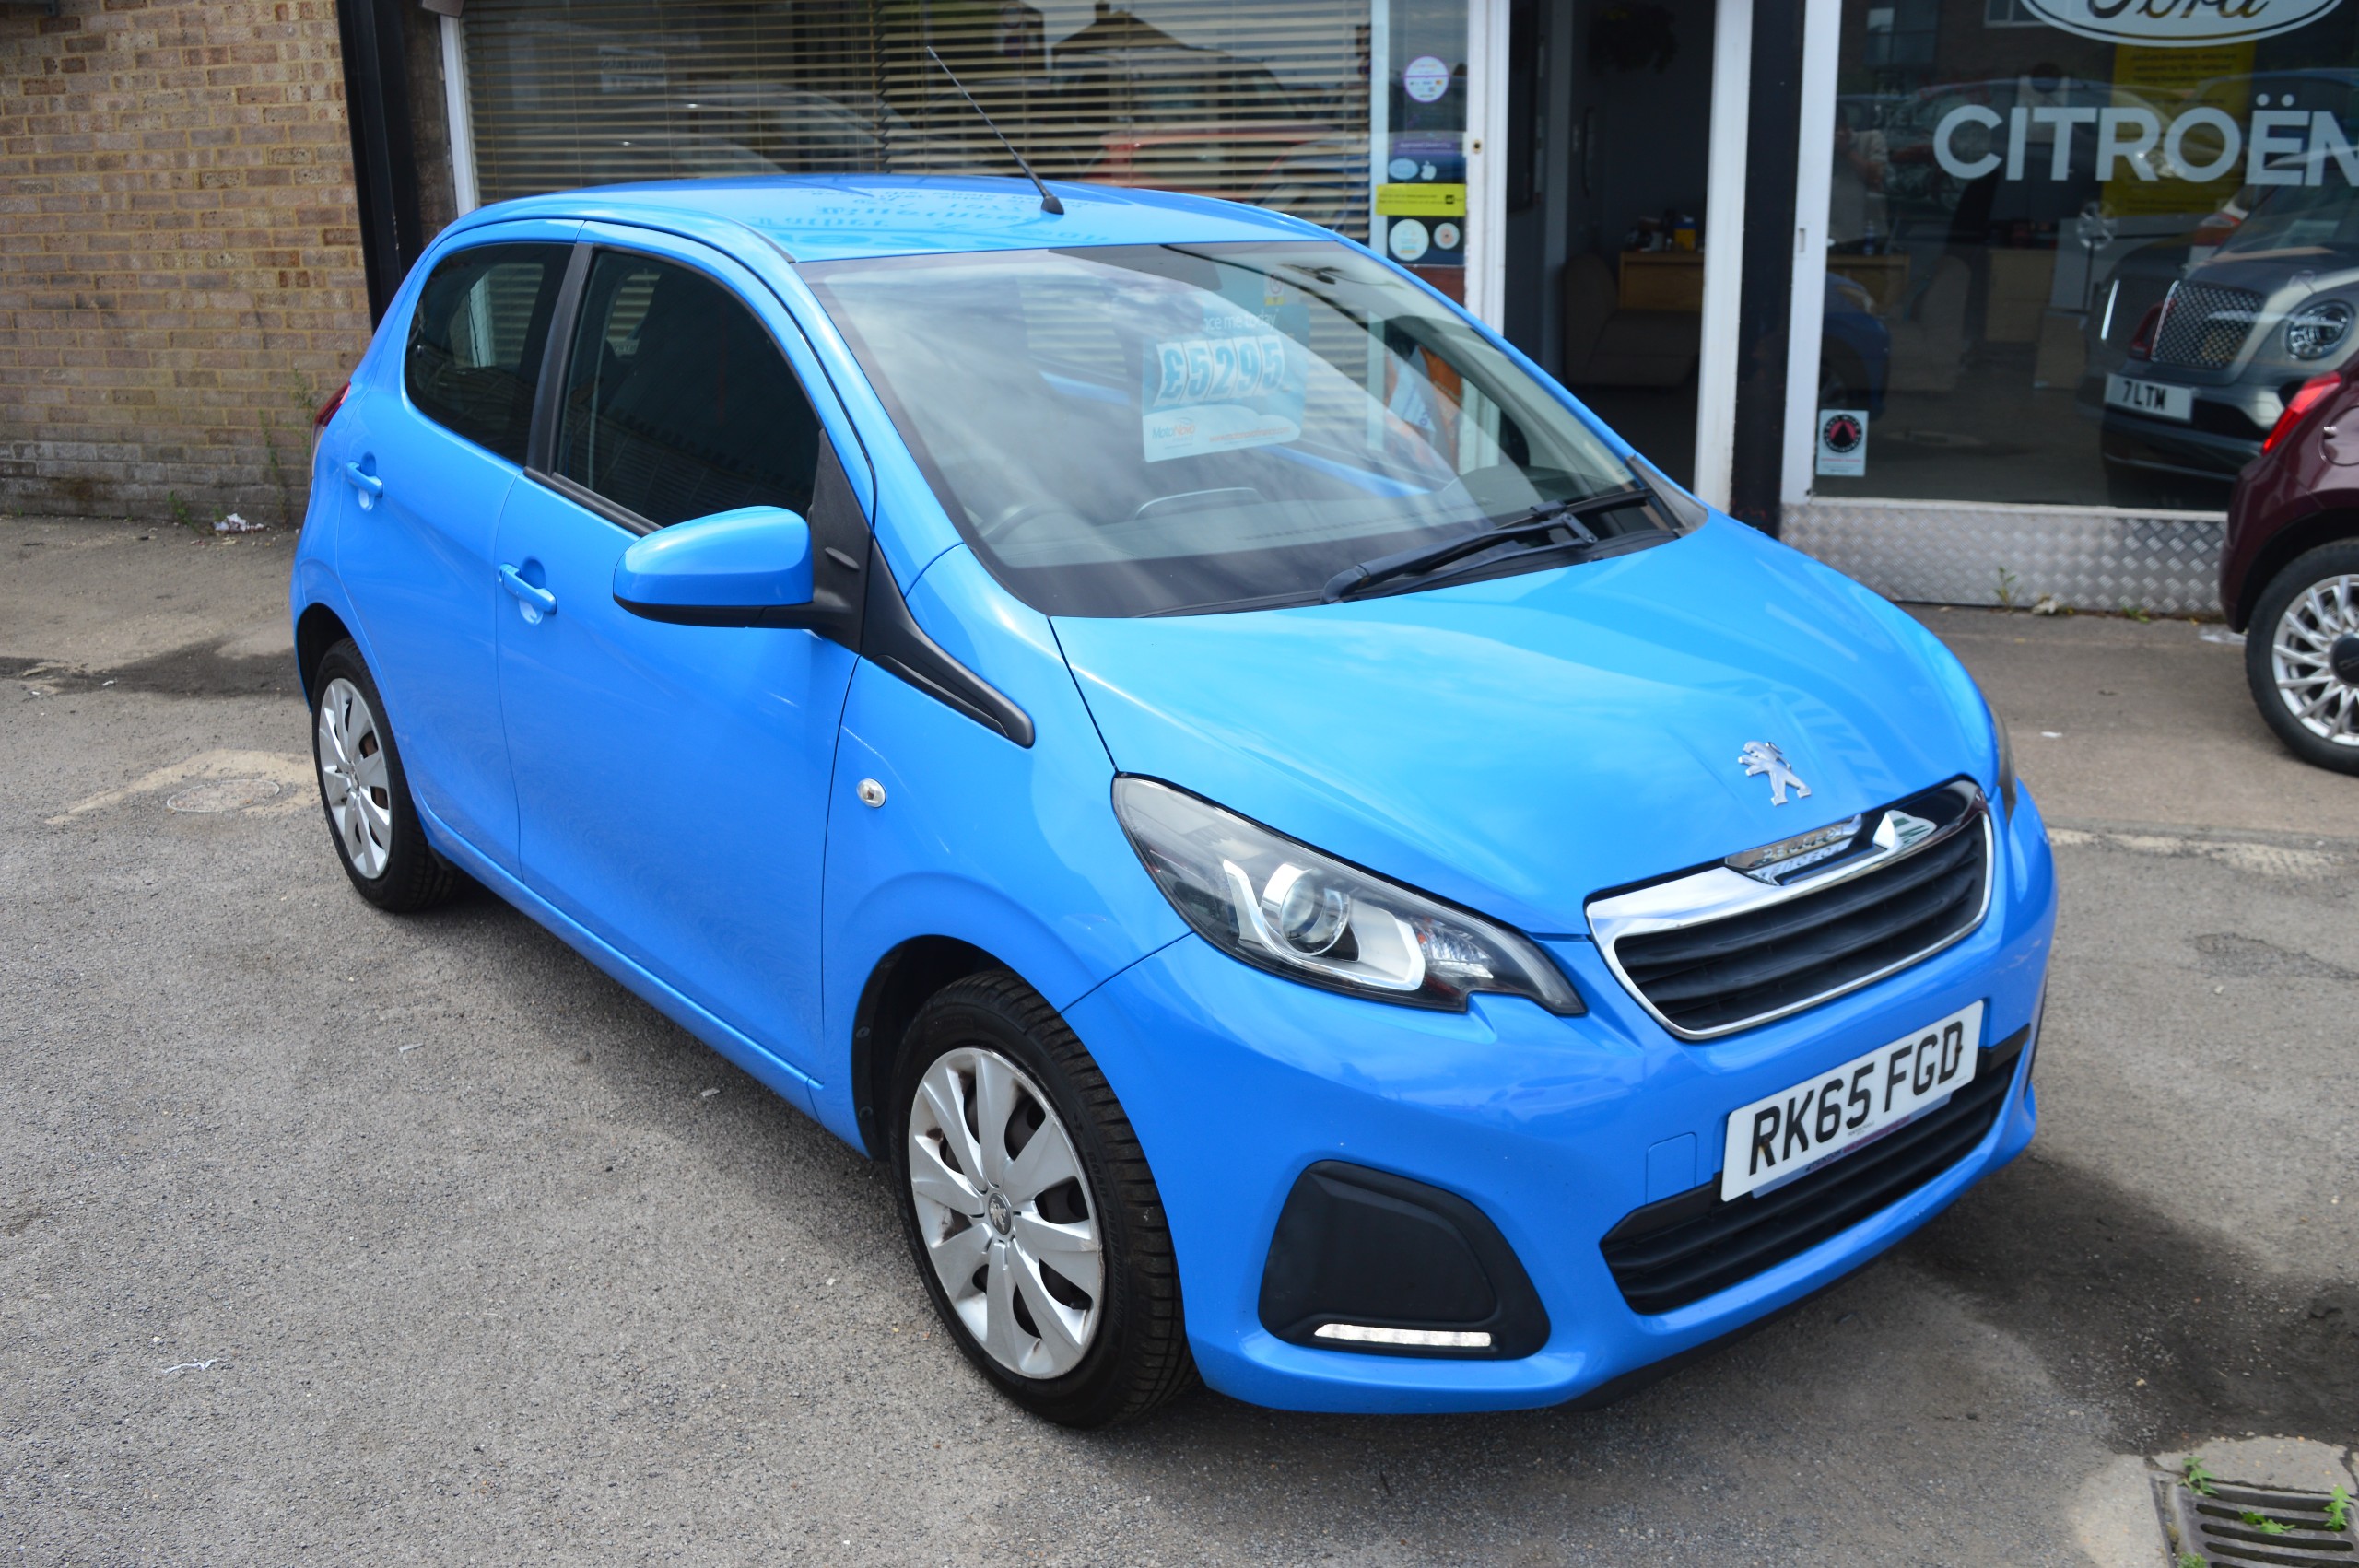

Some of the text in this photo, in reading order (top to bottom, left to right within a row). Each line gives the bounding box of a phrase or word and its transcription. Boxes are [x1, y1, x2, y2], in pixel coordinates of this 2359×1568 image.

[1932, 93, 2359, 187] CITROËN
[1161, 342, 1283, 399] £5295
[1152, 423, 1196, 439] MotoNovo
[1749, 1062, 1876, 1176] RK65
[1884, 1020, 1964, 1113] FGD
